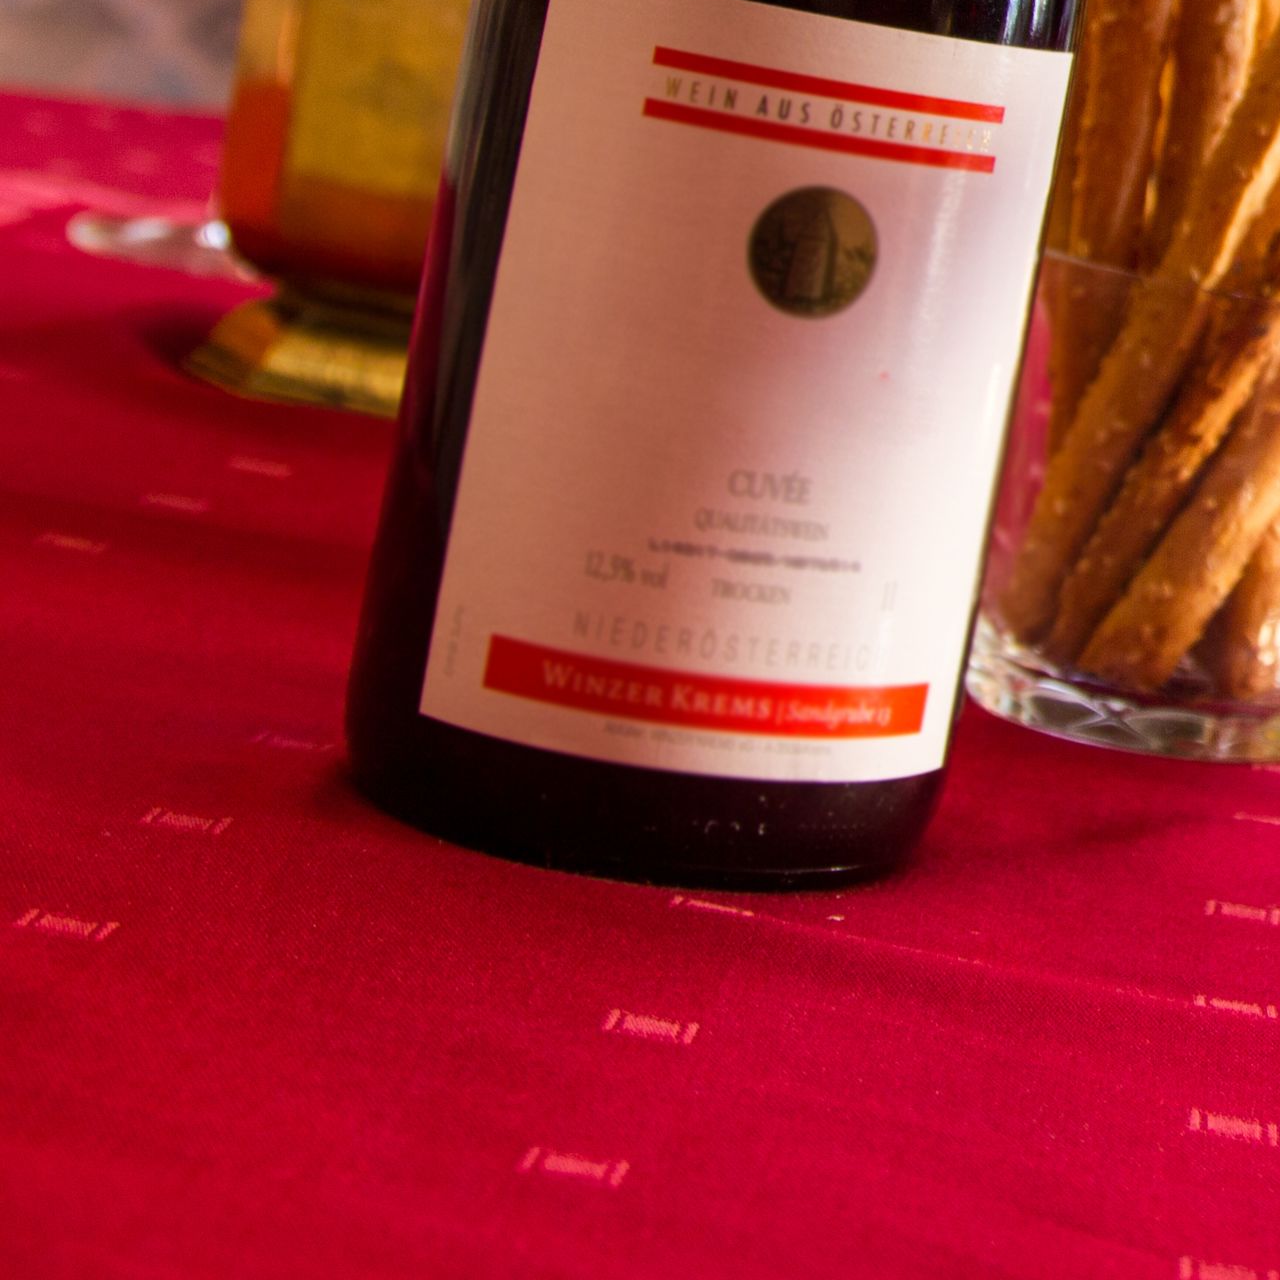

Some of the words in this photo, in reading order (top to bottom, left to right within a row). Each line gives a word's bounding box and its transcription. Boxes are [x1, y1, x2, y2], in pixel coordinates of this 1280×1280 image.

[665, 75, 738, 110] WEIN
[755, 94, 812, 124] AUS
[726, 470, 812, 505] CUVÉE
[711, 577, 792, 606] TROCKEN
[572, 611, 884, 673] NIEDERÖSTERREIC
[540, 658, 663, 707] WINZER
[669, 683, 771, 721] KREMS
